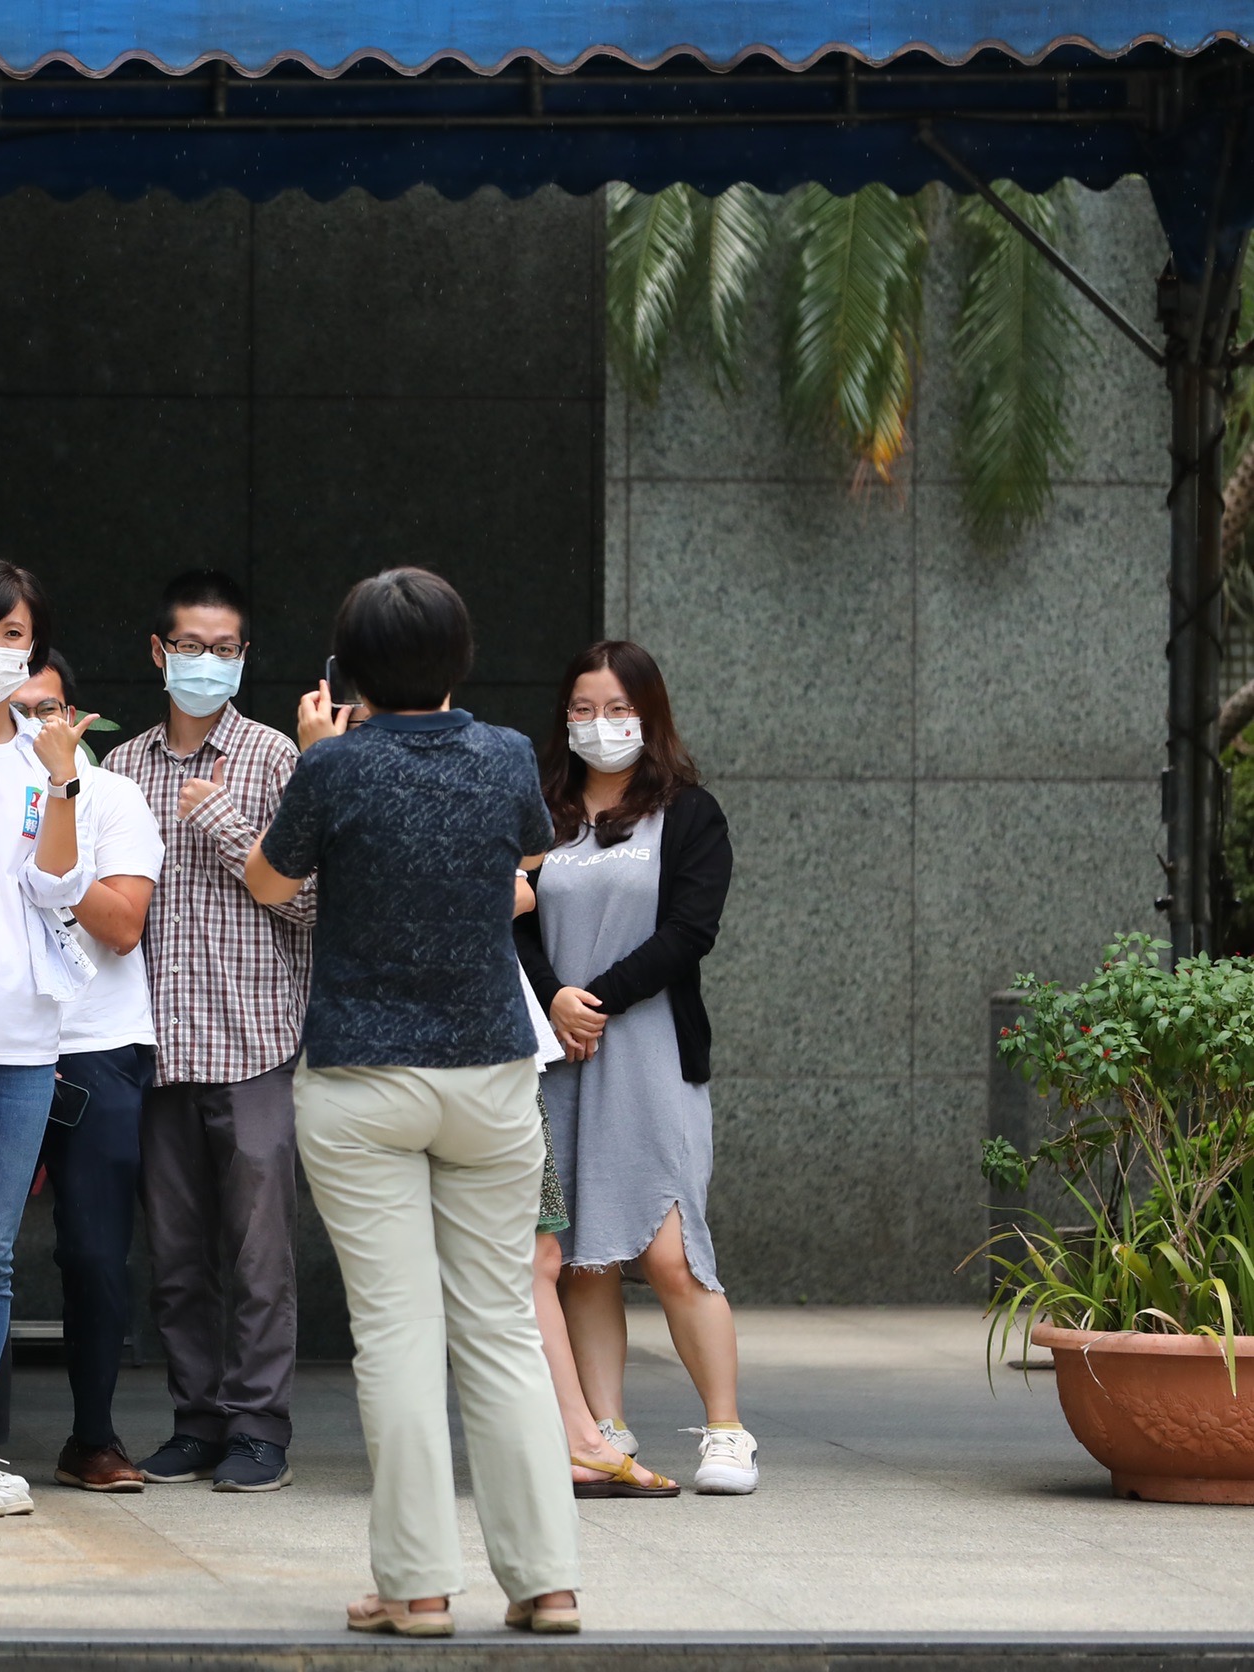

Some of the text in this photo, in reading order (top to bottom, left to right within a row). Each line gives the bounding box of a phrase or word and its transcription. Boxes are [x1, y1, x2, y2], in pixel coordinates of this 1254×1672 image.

[25, 805, 38, 833] 日報
[543, 848, 650, 867] NY JEANS
